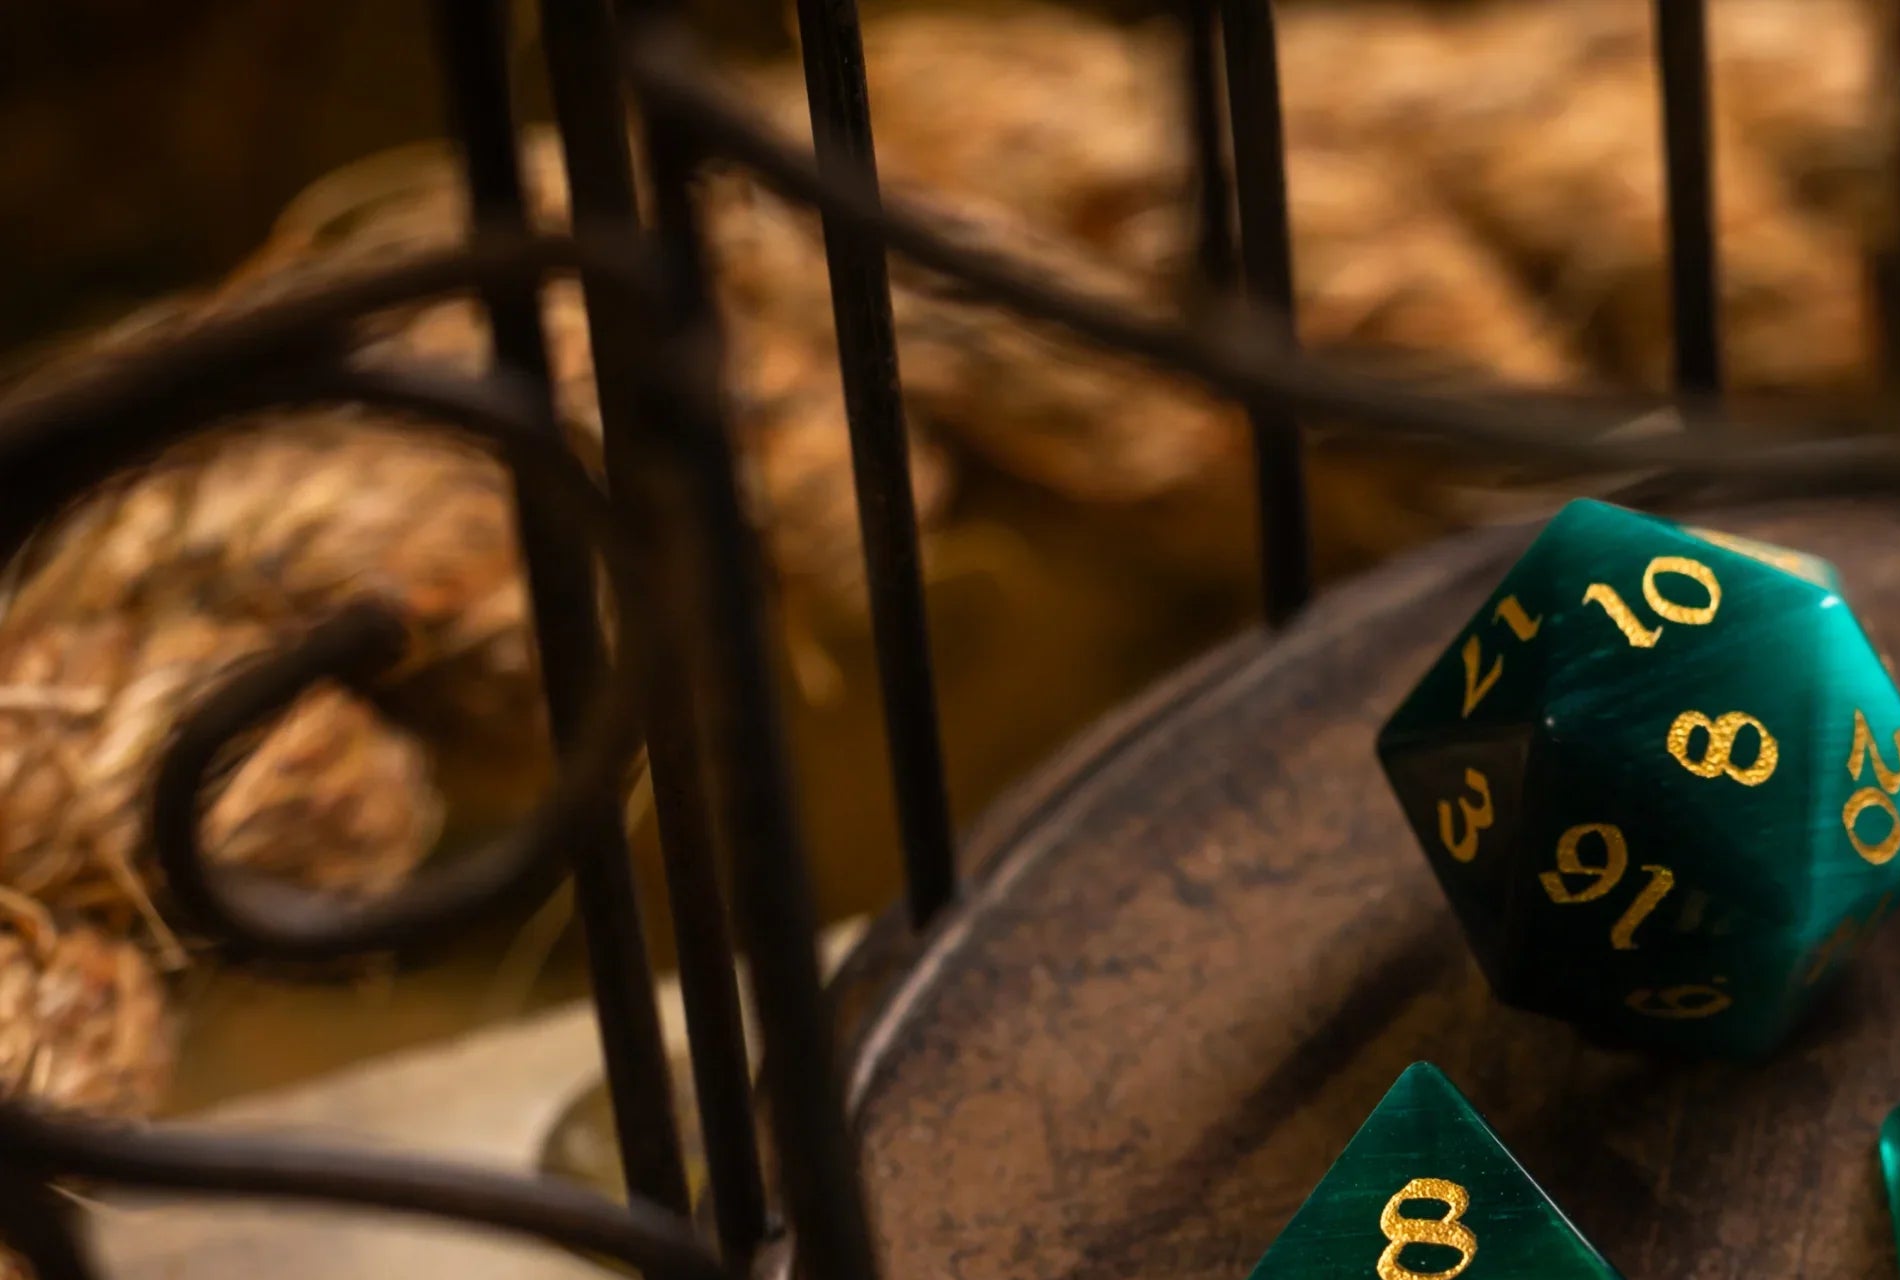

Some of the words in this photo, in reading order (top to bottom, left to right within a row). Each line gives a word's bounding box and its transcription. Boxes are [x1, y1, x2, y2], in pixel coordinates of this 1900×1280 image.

[1583, 555, 1722, 648] 10
[1461, 594, 1543, 718] 17
[1666, 709, 1779, 787] 8
[1436, 767, 1495, 864] 3
[1538, 823, 1675, 951] 16
